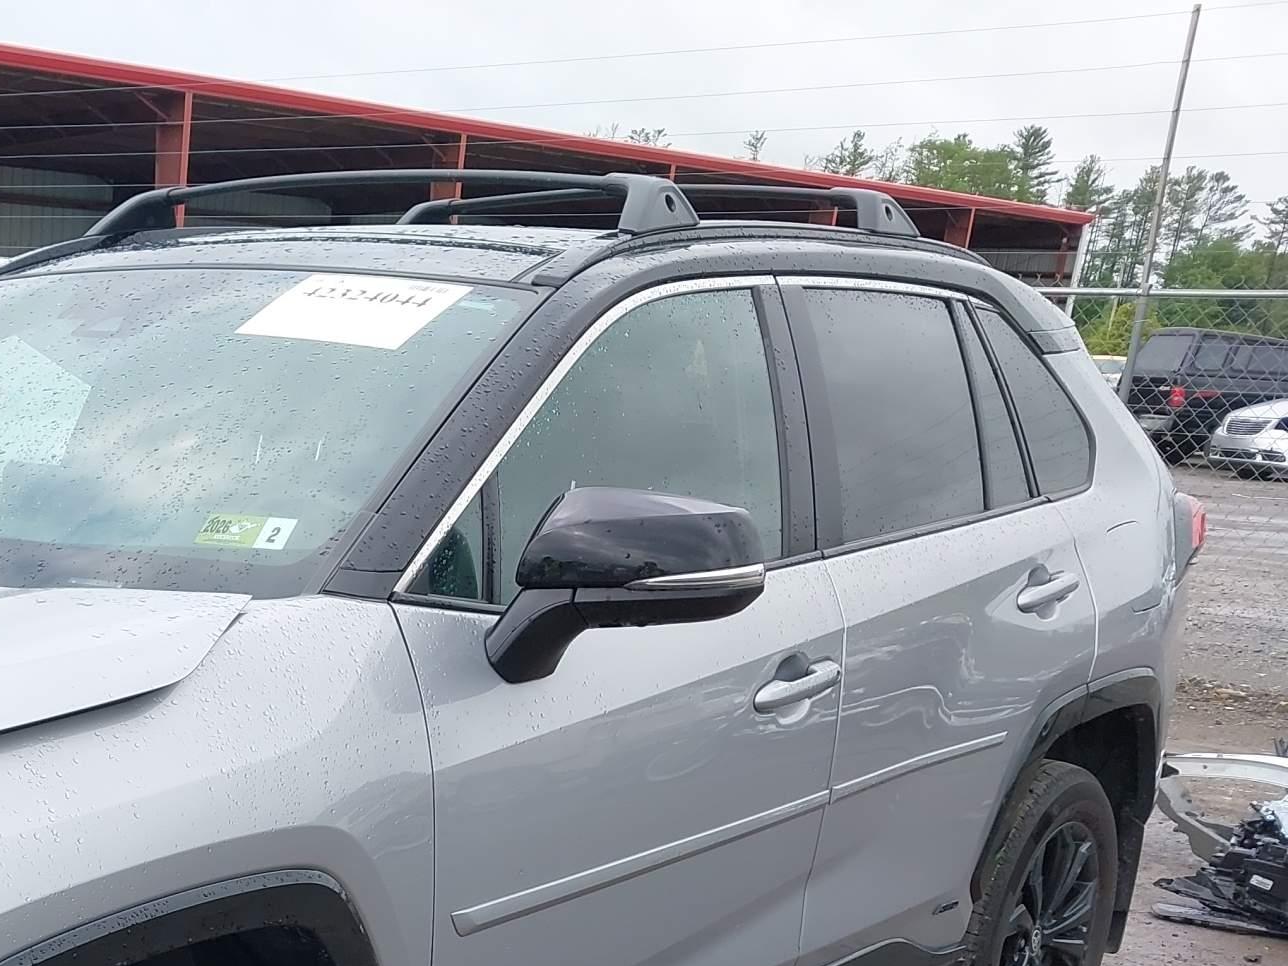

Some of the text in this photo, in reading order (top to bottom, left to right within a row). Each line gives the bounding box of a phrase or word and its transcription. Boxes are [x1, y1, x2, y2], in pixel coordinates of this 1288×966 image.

[304, 287, 432, 307] 42324044
[203, 518, 232, 533] 2026
[265, 527, 281, 543] 2
